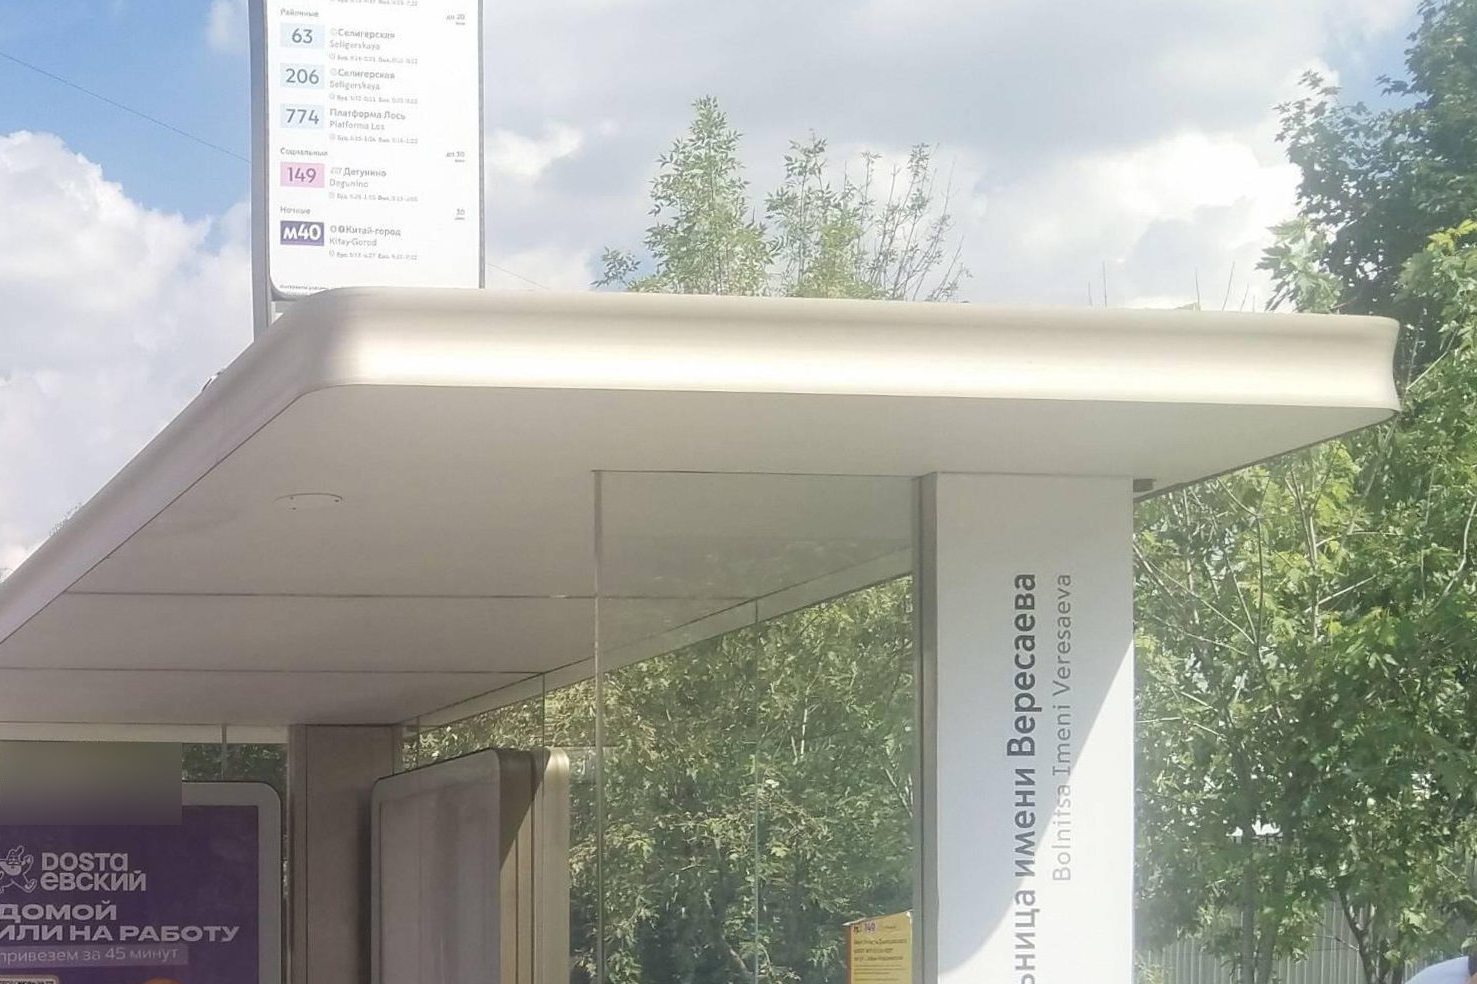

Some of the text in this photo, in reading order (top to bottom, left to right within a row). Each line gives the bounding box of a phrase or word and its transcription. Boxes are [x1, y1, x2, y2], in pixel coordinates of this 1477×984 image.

[291, 28, 314, 44] 63
[337, 28, 395, 40] Селигерская
[329, 39, 381, 51] Seligerskaya
[285, 68, 320, 85] 206
[337, 68, 395, 80] Селигерская
[329, 79, 381, 91] Seligerskaya
[285, 108, 320, 125] 774
[329, 108, 406, 121] Платформа Лось
[329, 120, 369, 131] Platforma
[287, 166, 317, 184] 149
[342, 167, 387, 179] Дегунино
[329, 178, 369, 189] Degunino
[345, 225, 402, 237] Китай-город
[1007, 573, 1043, 757] Вересаева
[1052, 573, 1072, 881] Bolnitsa Imeni Veresaeva
[1014, 767, 1036, 878] имени
[69, 925, 114, 942] НА
[119, 925, 240, 943] РАБОТУ
[82, 952, 101, 961] за
[104, 947, 126, 960] 45
[129, 947, 179, 962] минут
